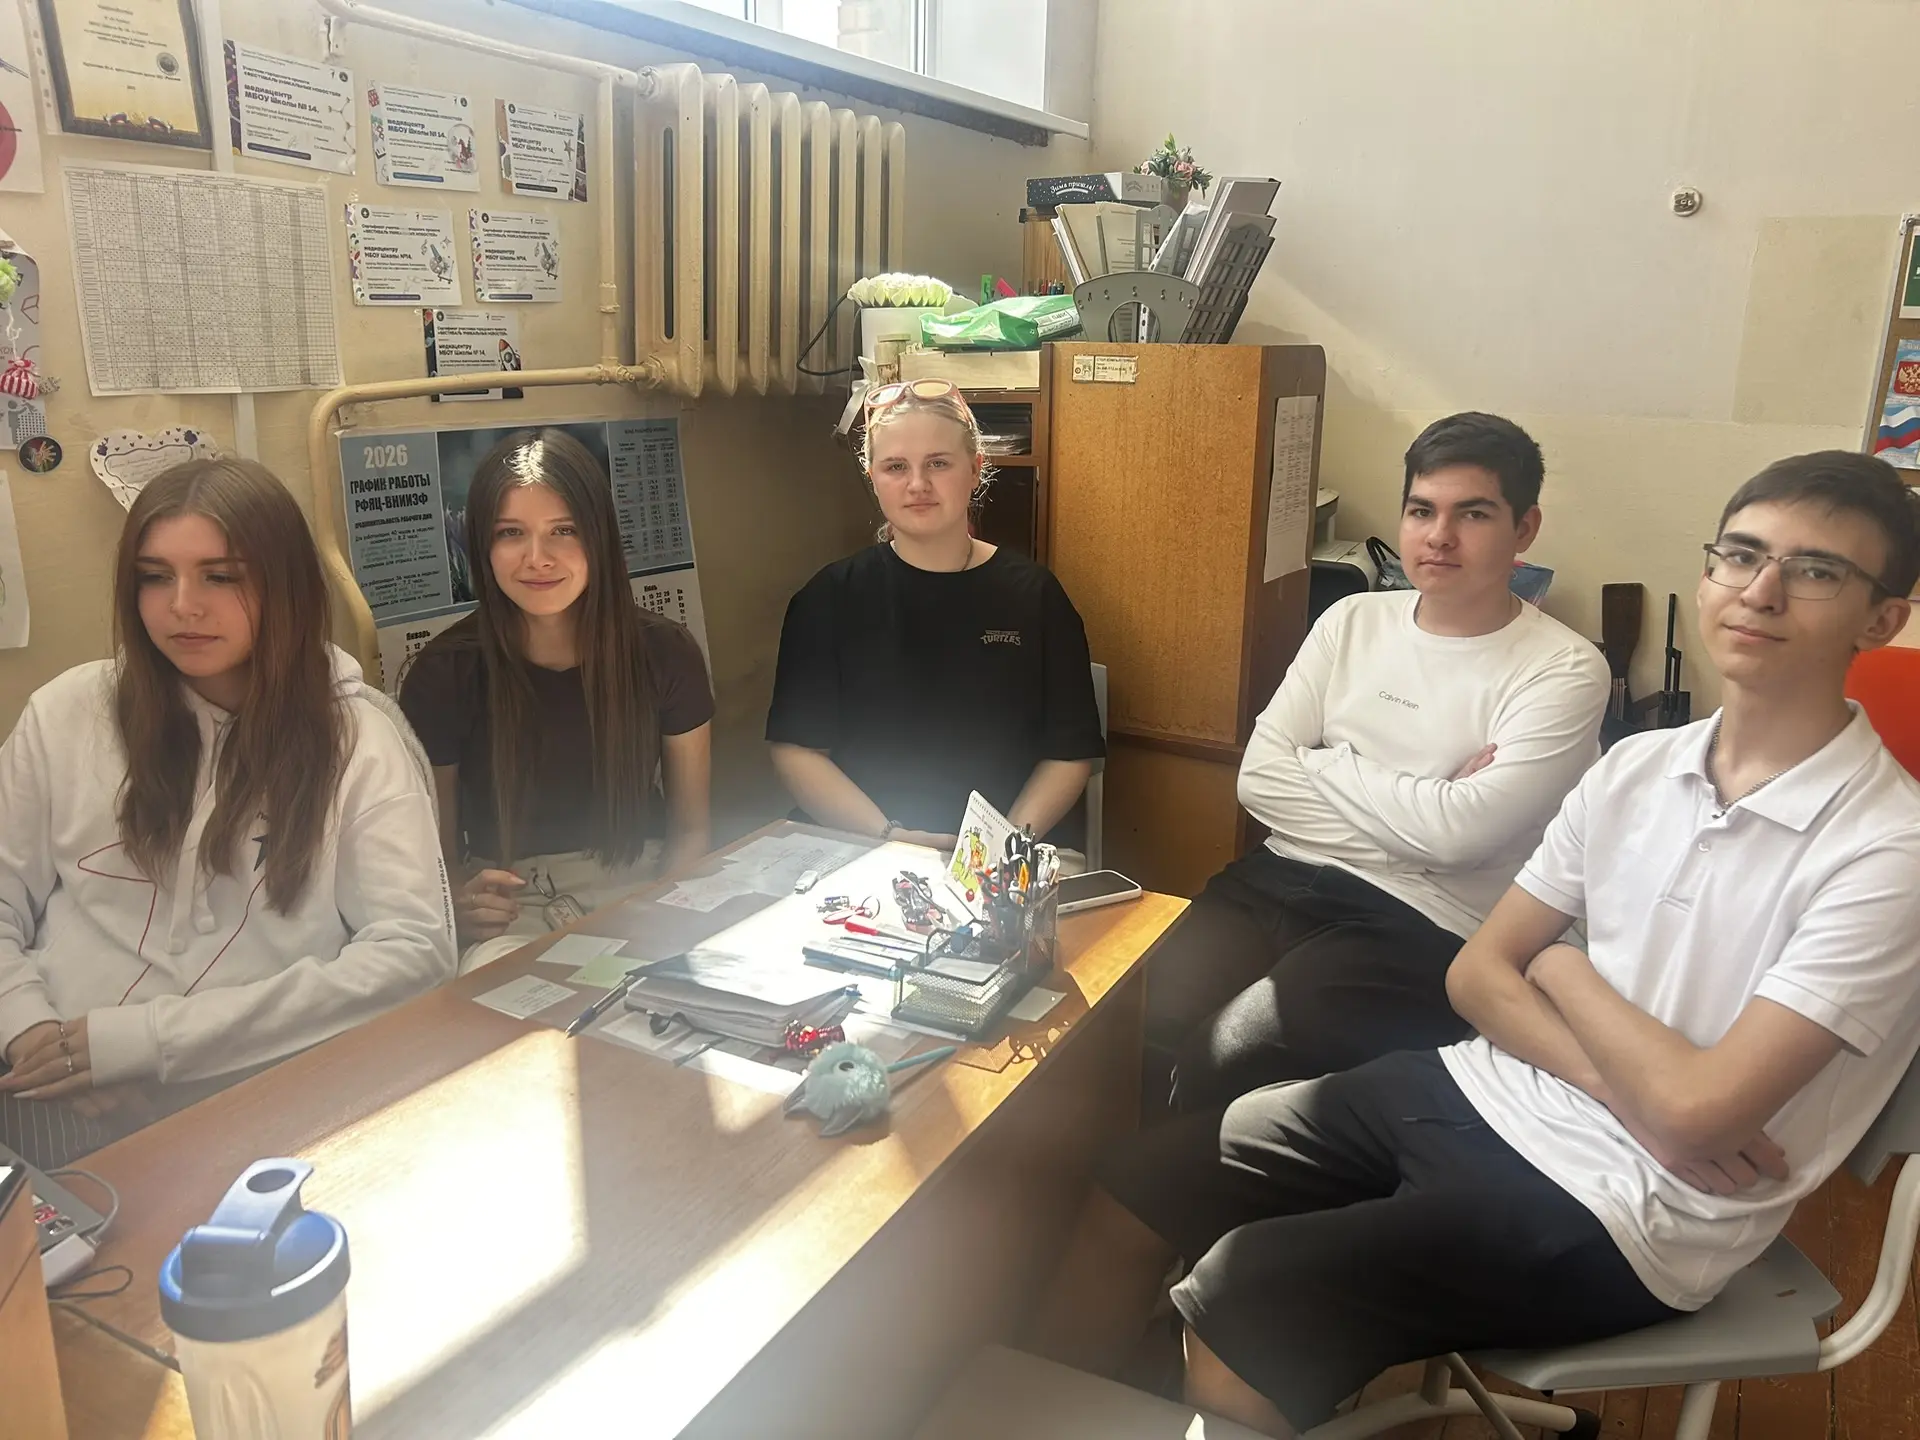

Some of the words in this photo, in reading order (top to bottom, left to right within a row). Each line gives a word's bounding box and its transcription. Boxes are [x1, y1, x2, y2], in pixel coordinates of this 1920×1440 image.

[244, 84, 292, 100] медиацентр
[245, 91, 269, 103] МБОУ
[270, 96, 297, 108] Школы
[298, 102, 307, 110] №
[308, 104, 319, 113] 14,
[387, 119, 425, 129] медиацентр
[388, 125, 407, 133] МБОУ
[409, 128, 428, 136] Школы
[1050, 183, 1067, 193] Зима
[1069, 182, 1095, 191] пришла!
[363, 444, 408, 469] 2026
[350, 477, 387, 494] ГРАФИК
[388, 473, 430, 490] РАБОТЫ
[355, 492, 428, 512] РФЯЦ-ВНИИЭФ
[980, 634, 1020, 646] TURTLES
[1379, 691, 1401, 704] Calvin
[1402, 699, 1419, 709] Klein
